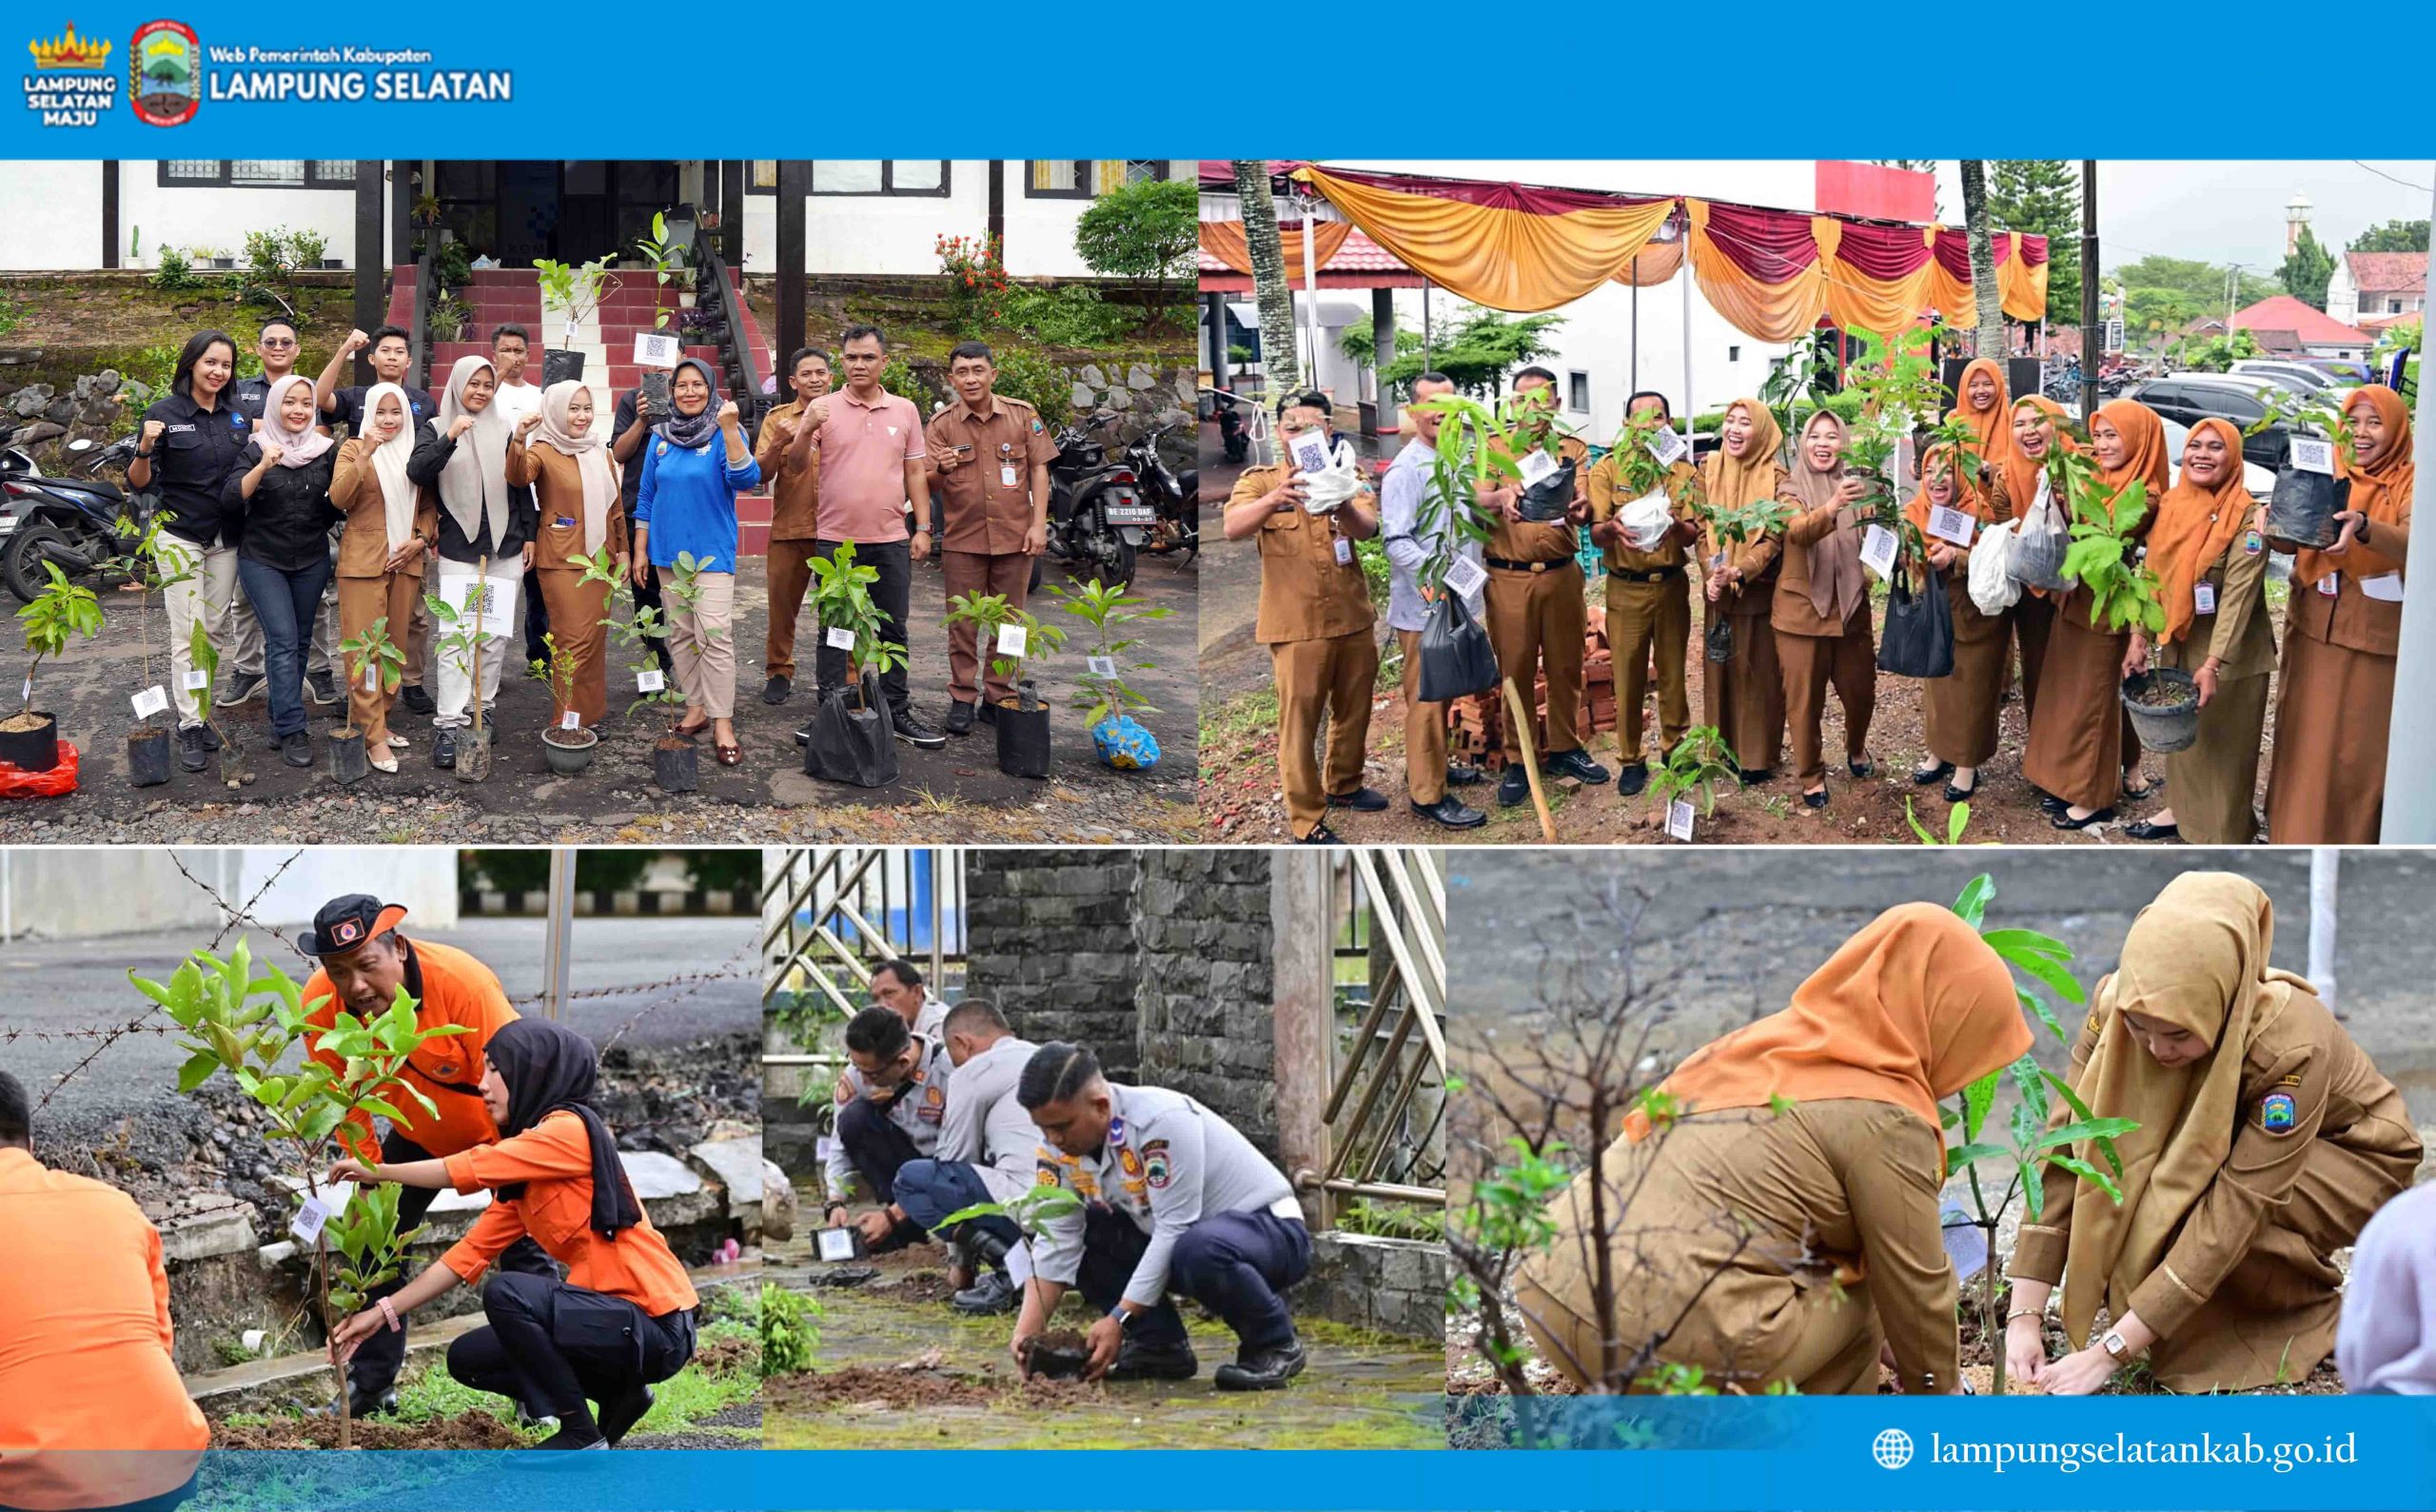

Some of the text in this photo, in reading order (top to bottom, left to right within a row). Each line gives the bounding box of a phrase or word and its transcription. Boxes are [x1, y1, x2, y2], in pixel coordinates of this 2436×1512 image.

[1108, 507, 1152, 516] BE 2210 DAF
